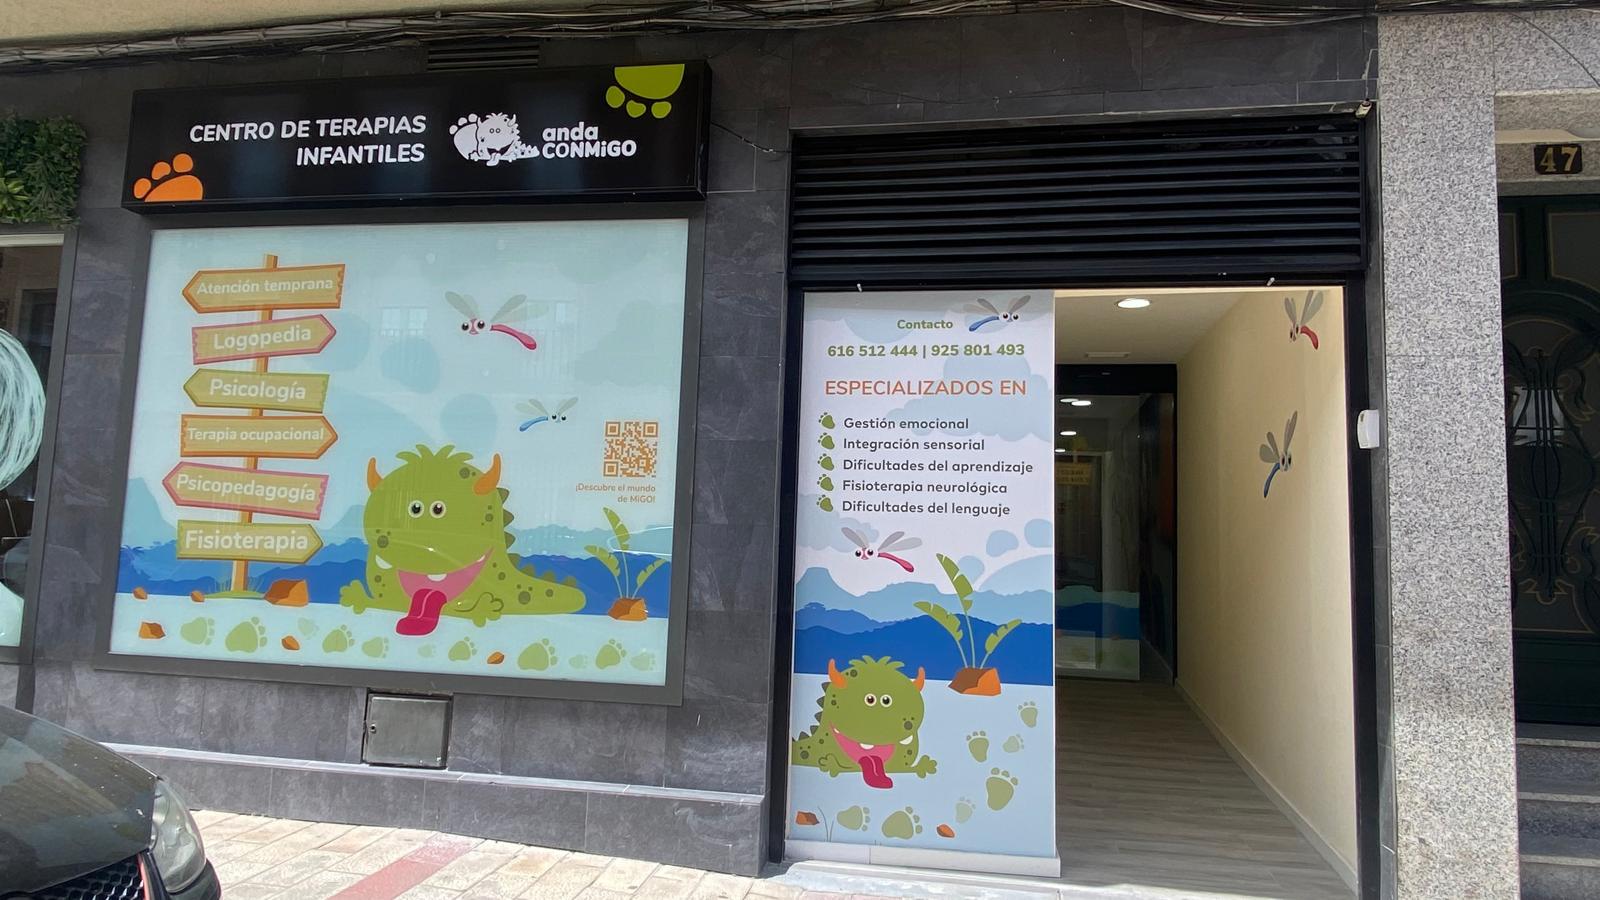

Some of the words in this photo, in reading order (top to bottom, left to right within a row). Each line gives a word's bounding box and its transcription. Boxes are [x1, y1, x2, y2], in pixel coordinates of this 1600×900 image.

[189, 120, 274, 142] CENTRO
[280, 118, 310, 139] DE
[316, 115, 427, 138] TERAPIAS
[542, 121, 598, 142] anda
[296, 143, 425, 167] INFANTILES
[542, 138, 637, 160] CONMiGO
[1540, 146, 1578, 172] 47
[197, 279, 260, 296] Atención
[264, 278, 334, 296] temprana
[897, 319, 953, 331] Contacto
[213, 325, 312, 351] Logopedia
[828, 345, 854, 357] 616
[859, 345, 886, 357] 512
[890, 345, 918, 357] 444
[931, 344, 958, 357] 925
[963, 344, 992, 356] 801
[996, 343, 1025, 356] 493
[209, 378, 307, 404] Psicología
[825, 380, 993, 396] ESPECIALIZADOS
[1000, 380, 1026, 396] EN
[844, 417, 896, 430] Gestión
[899, 417, 969, 430] emocional
[187, 427, 237, 443] Terapia
[240, 427, 324, 443] ocupacional
[843, 438, 919, 453] Integración
[923, 439, 985, 451] sensorial
[843, 459, 924, 472] Dificultades
[928, 460, 948, 472] del
[952, 461, 1034, 475] aprendizaje
[176, 473, 316, 503] Psicopedagogía
[618, 483, 625, 491] el
[627, 484, 656, 492] mundo
[842, 480, 923, 494] Fisioterapia
[927, 481, 1008, 496] neurológica
[617, 495, 628, 503] de
[842, 500, 924, 513] Dificultades
[927, 501, 948, 514] del
[951, 502, 1011, 517] lenguaje
[185, 529, 309, 554] Fisioterapia
